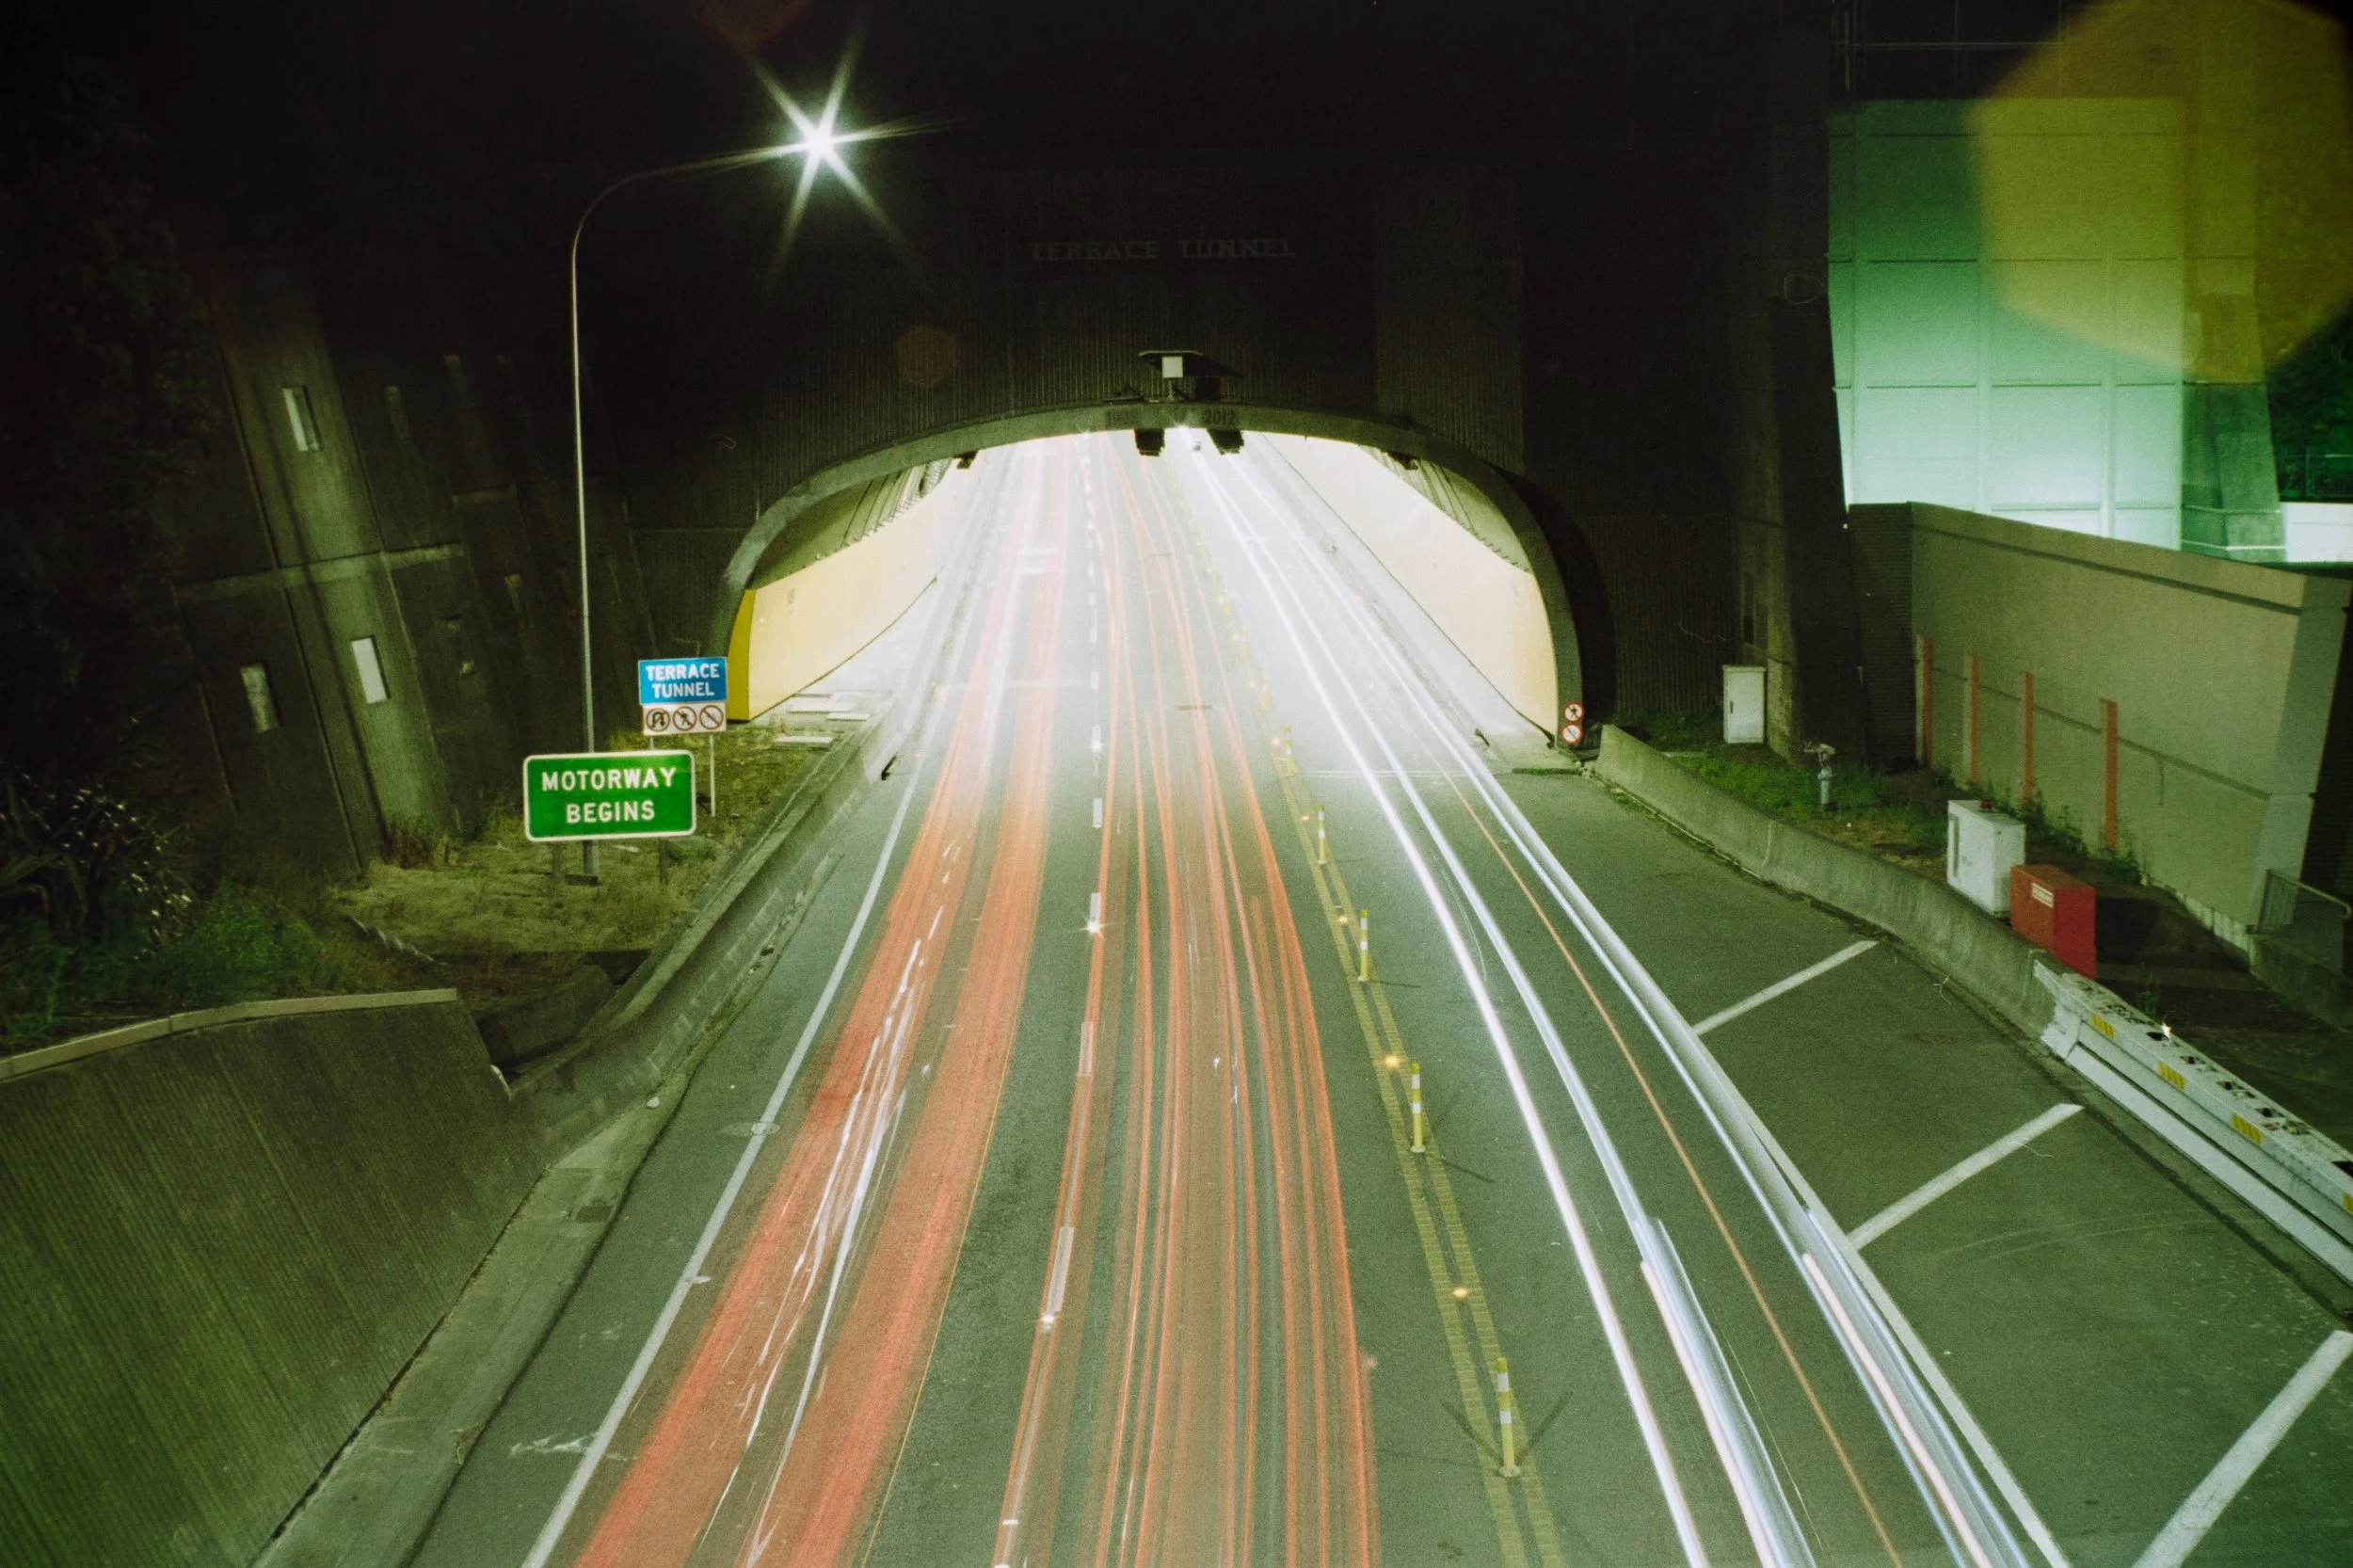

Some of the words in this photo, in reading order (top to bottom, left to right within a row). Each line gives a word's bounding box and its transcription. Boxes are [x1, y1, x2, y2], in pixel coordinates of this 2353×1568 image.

[1029, 239, 1160, 262] TERRACE
[1177, 237, 1296, 259] TUNNEL
[646, 663, 720, 681] TERRACE
[651, 681, 715, 698] TUNNEL
[541, 766, 677, 792] MOTORWAY
[566, 799, 655, 824] BEGINS
